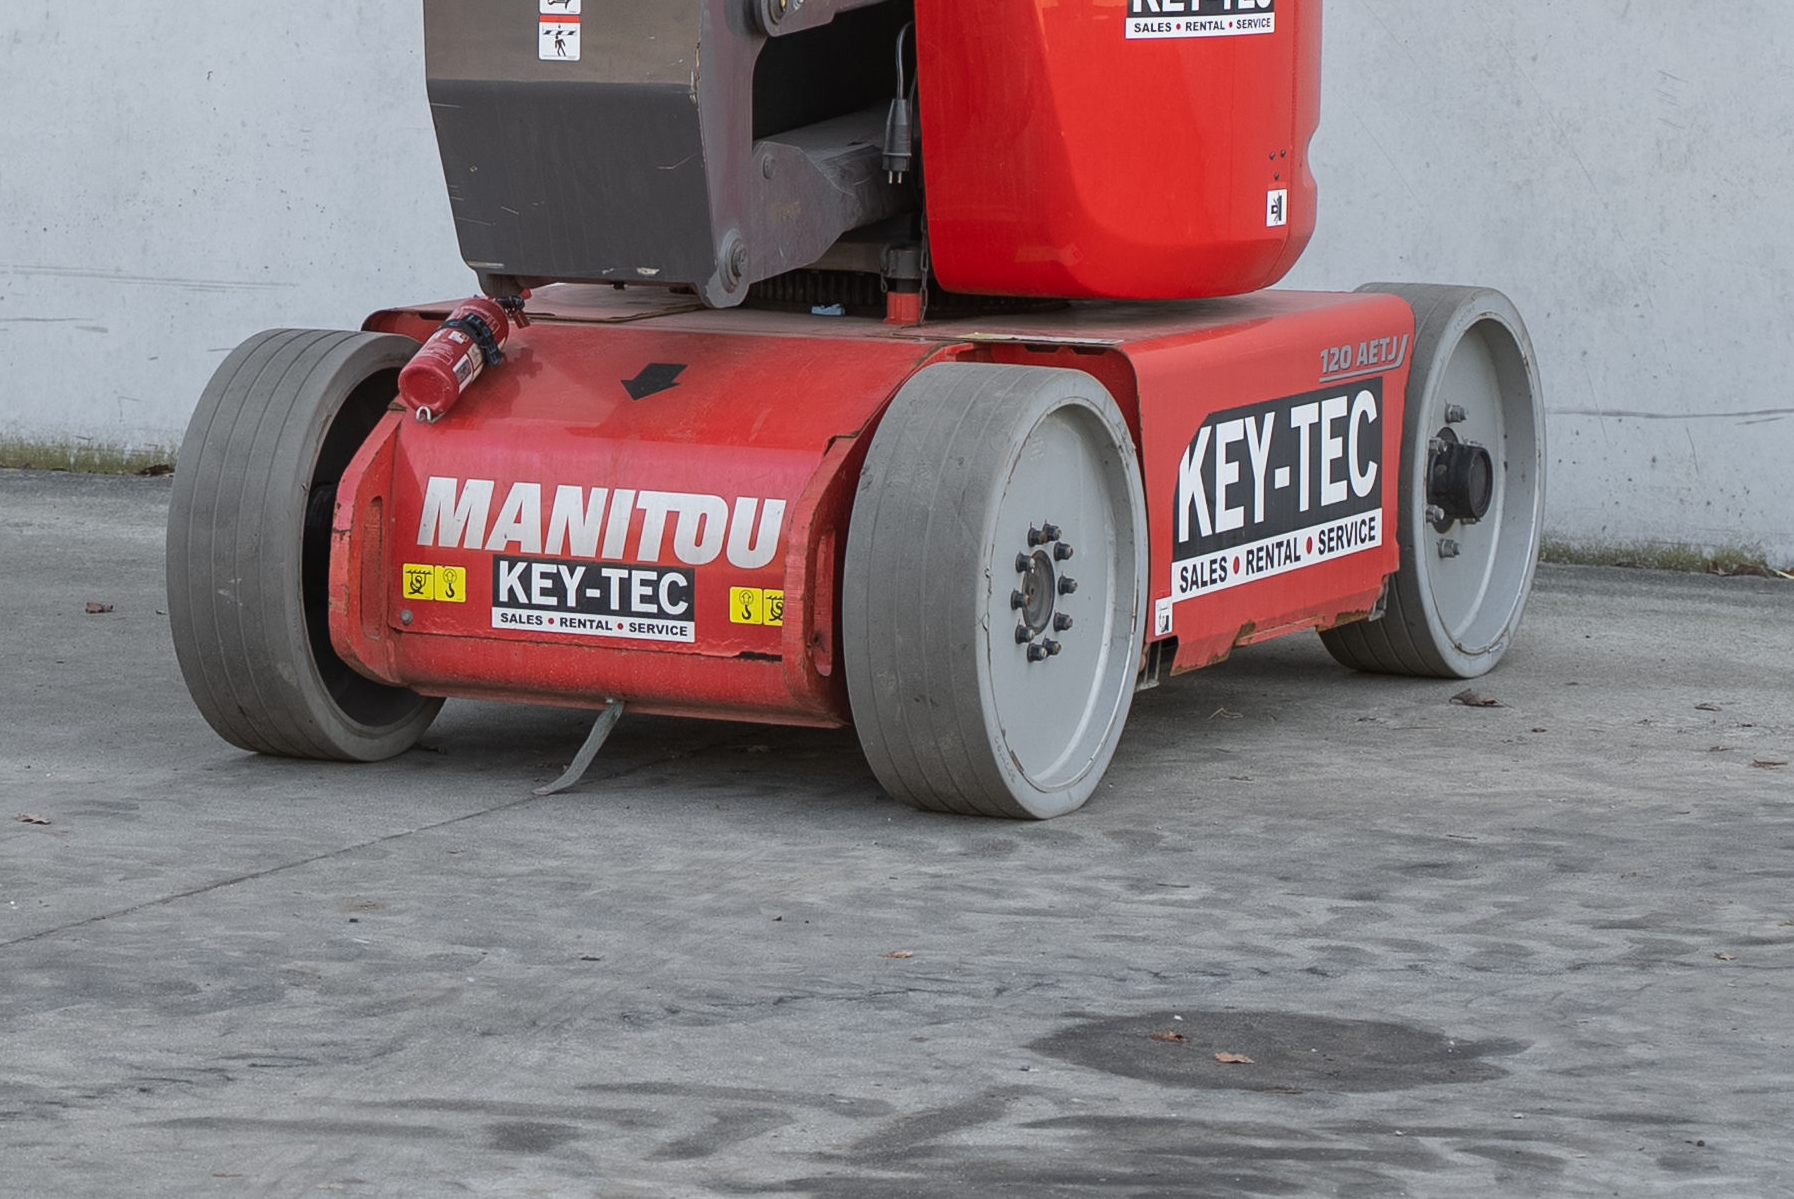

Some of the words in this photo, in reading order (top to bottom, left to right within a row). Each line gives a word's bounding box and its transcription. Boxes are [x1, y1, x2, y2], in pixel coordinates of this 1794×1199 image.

[1134, 21, 1172, 33] SALES
[1185, 20, 1226, 32] RENTAL
[1236, 18, 1271, 30] SERVICE
[1320, 345, 1353, 374] 120
[1178, 389, 1378, 543] KEY-TEC
[416, 476, 787, 569] MANITOU
[1179, 556, 1228, 593] SALES
[1245, 537, 1301, 576] RENTAL
[1318, 516, 1376, 555] SERVICE
[499, 560, 689, 615] KEY-TEC
[500, 612, 543, 626] SALES
[560, 617, 613, 631] RENTAL
[629, 622, 688, 637] SERVICE
